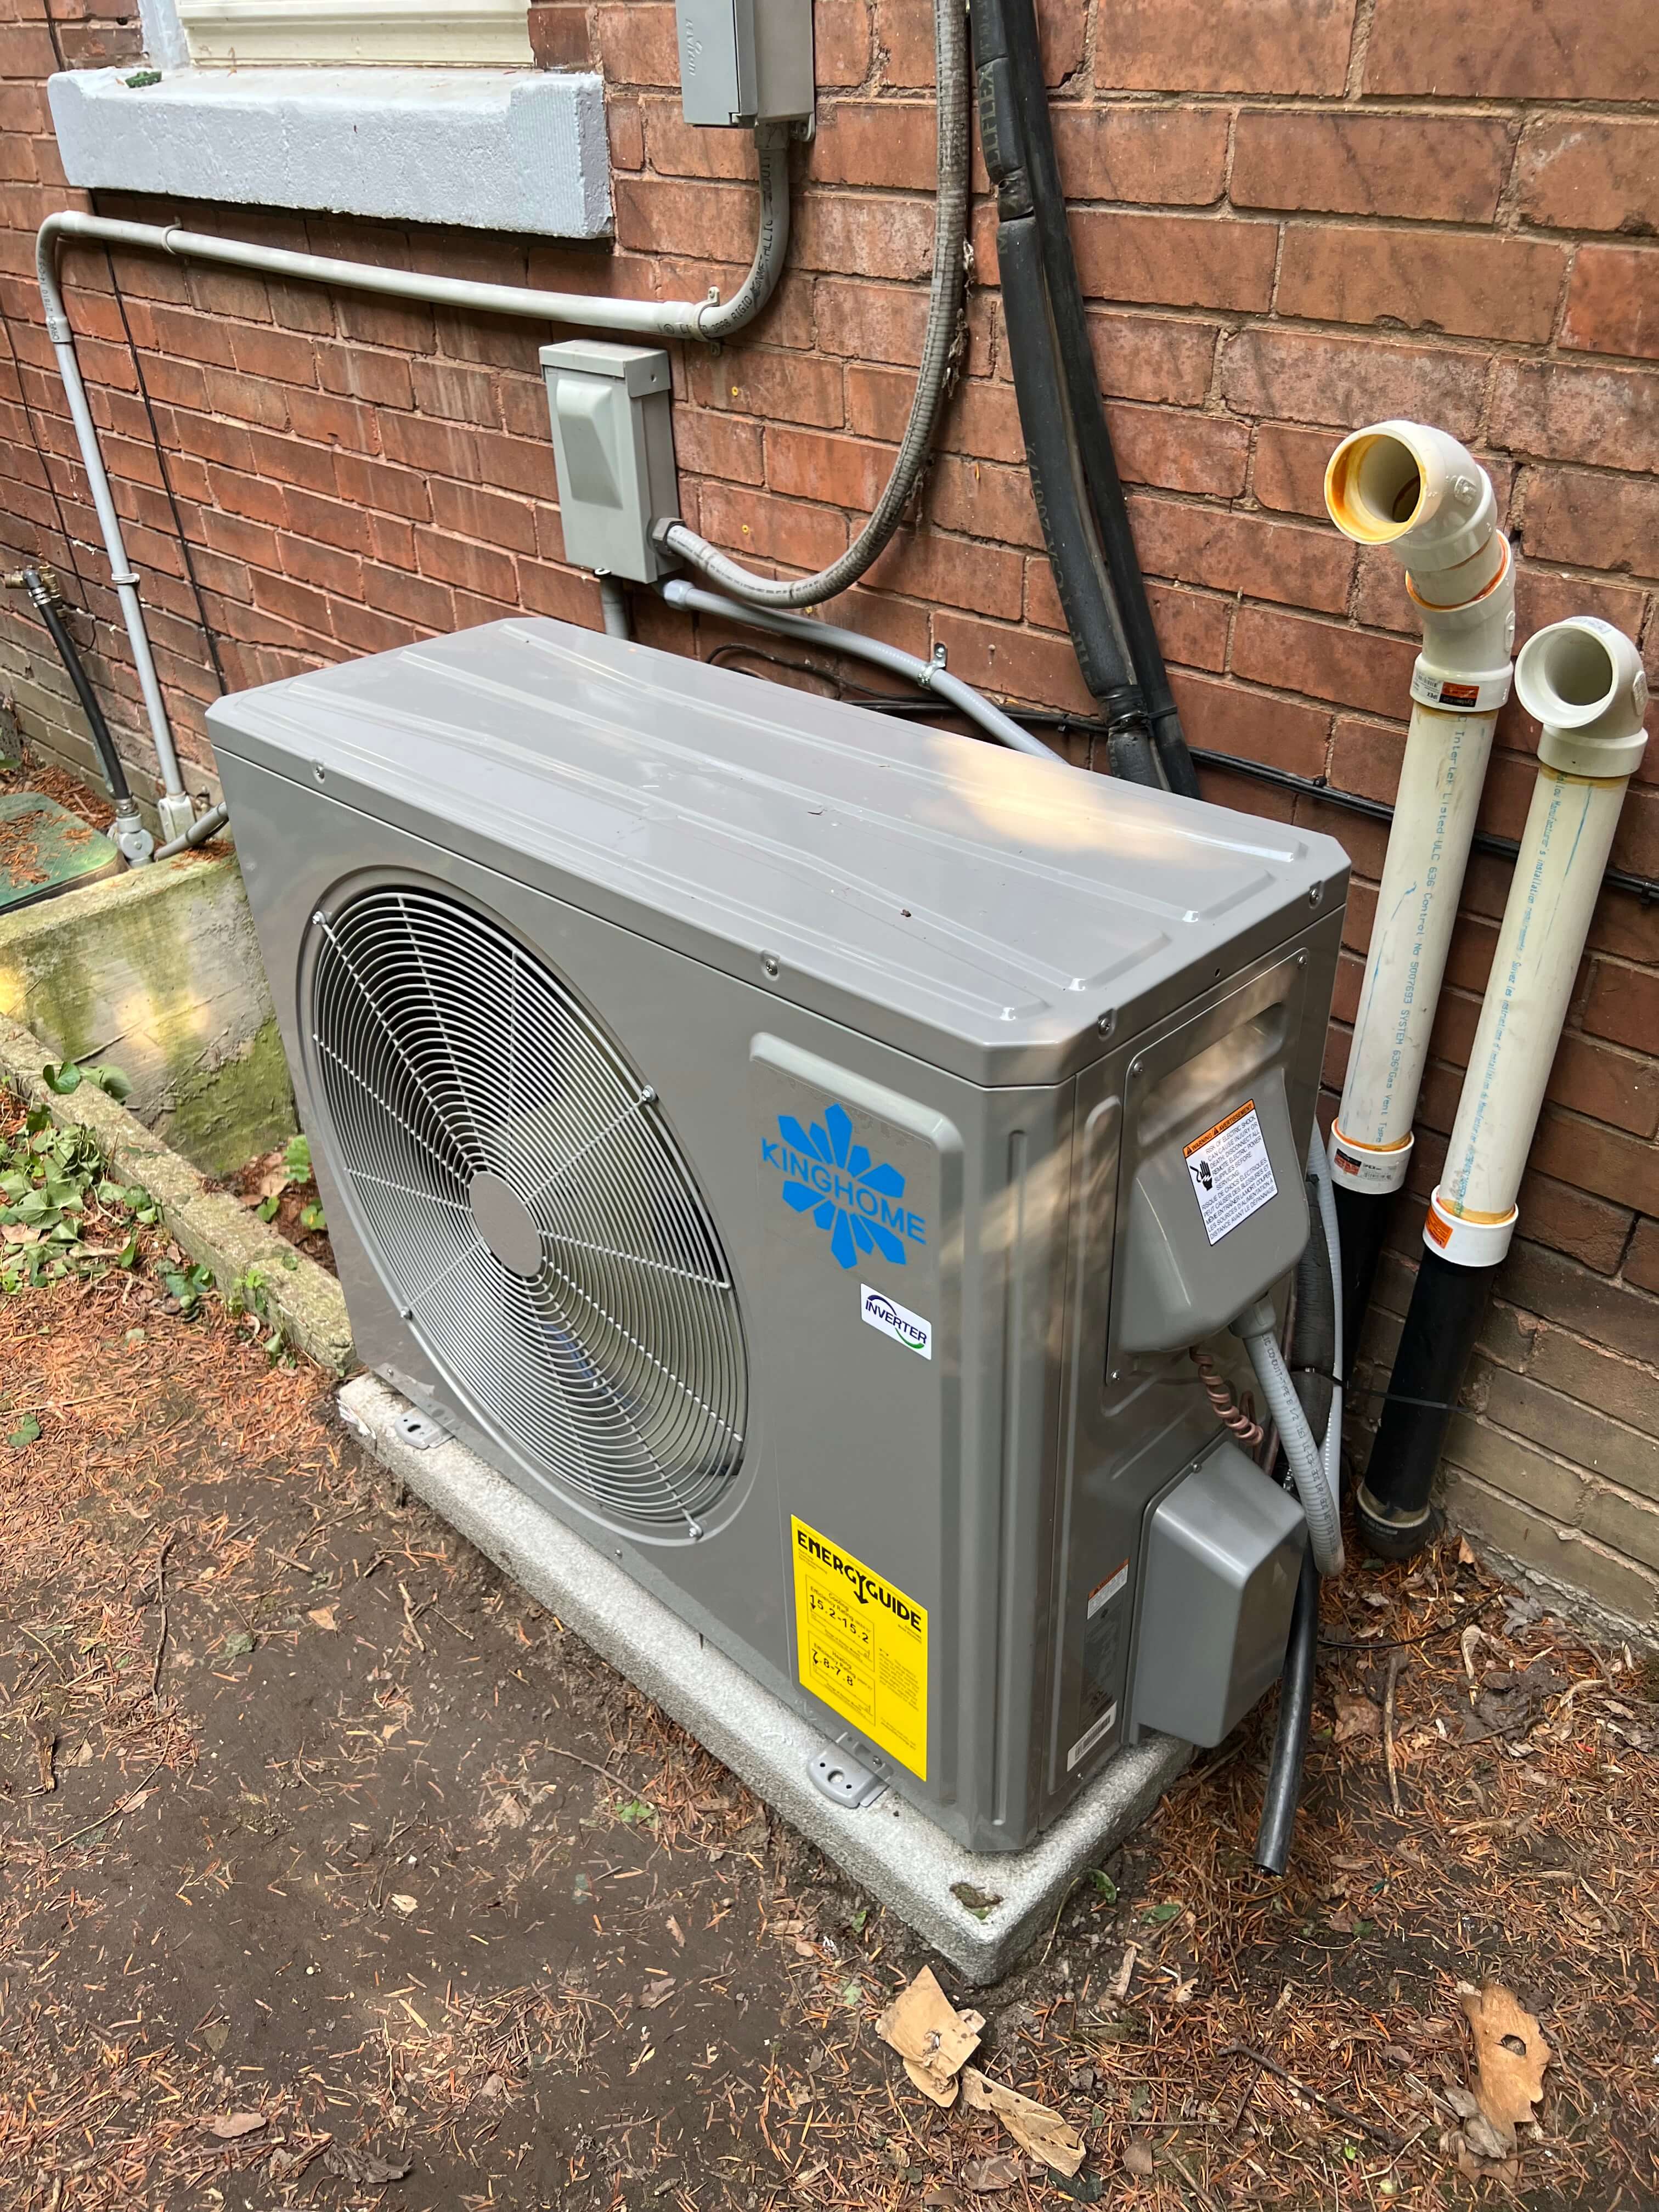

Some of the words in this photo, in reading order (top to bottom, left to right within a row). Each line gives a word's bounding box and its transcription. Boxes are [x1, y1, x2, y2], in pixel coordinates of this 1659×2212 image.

[1444, 730, 1465, 787] Intertek
[1435, 792, 1453, 835] Listed
[1430, 839, 1443, 861] ULC
[1425, 866, 1438, 888] 636
[1527, 859, 1547, 904] installation
[1415, 891, 1433, 936] Control
[1402, 960, 1419, 1005] 5007693
[1506, 960, 1521, 984] Suivez
[1504, 985, 1515, 997] les
[1393, 1008, 1410, 1046] SYSTEM
[1380, 1092, 1393, 1117] Vent
[1191, 1131, 1212, 1151] WARNING
[1218, 1102, 1252, 1132] AVERTISSEMENT
[1222, 1124, 1242, 1143] ELECTRIC
[1374, 1121, 1387, 1144] Type
[1207, 1150, 1218, 1162] CAN
[1217, 1138, 1234, 1155] CAUSE
[1233, 1126, 1250, 1143] INJURY
[1225, 1133, 1252, 1158] DISCONNECT
[1251, 1128, 1260, 1138] ALL
[1212, 1159, 1229, 1177] REMOTE
[1228, 1146, 1248, 1164] ELECTRIC
[1214, 1164, 1234, 1184] SUPPLIES
[1234, 1150, 1252, 1168] BEFORE
[761, 1136, 926, 1246] KINGHOME
[1255, 1170, 1272, 1187] COUPER
[1201, 1194, 1217, 1211] RISQUE
[1203, 1205, 1215, 1218] PEUT
[1215, 1192, 1232, 1210] CAUSER
[1232, 1185, 1241, 1197] DES
[1207, 1221, 1217, 1233] LES
[1216, 1205, 1237, 1226] SOURCES
[1210, 1219, 1231, 1240] DISTANCE
[1231, 1208, 1244, 1223] AVANT
[864, 1299, 927, 1344] INVERTER
[797, 1530, 922, 1633] ENERGYGUIDE
